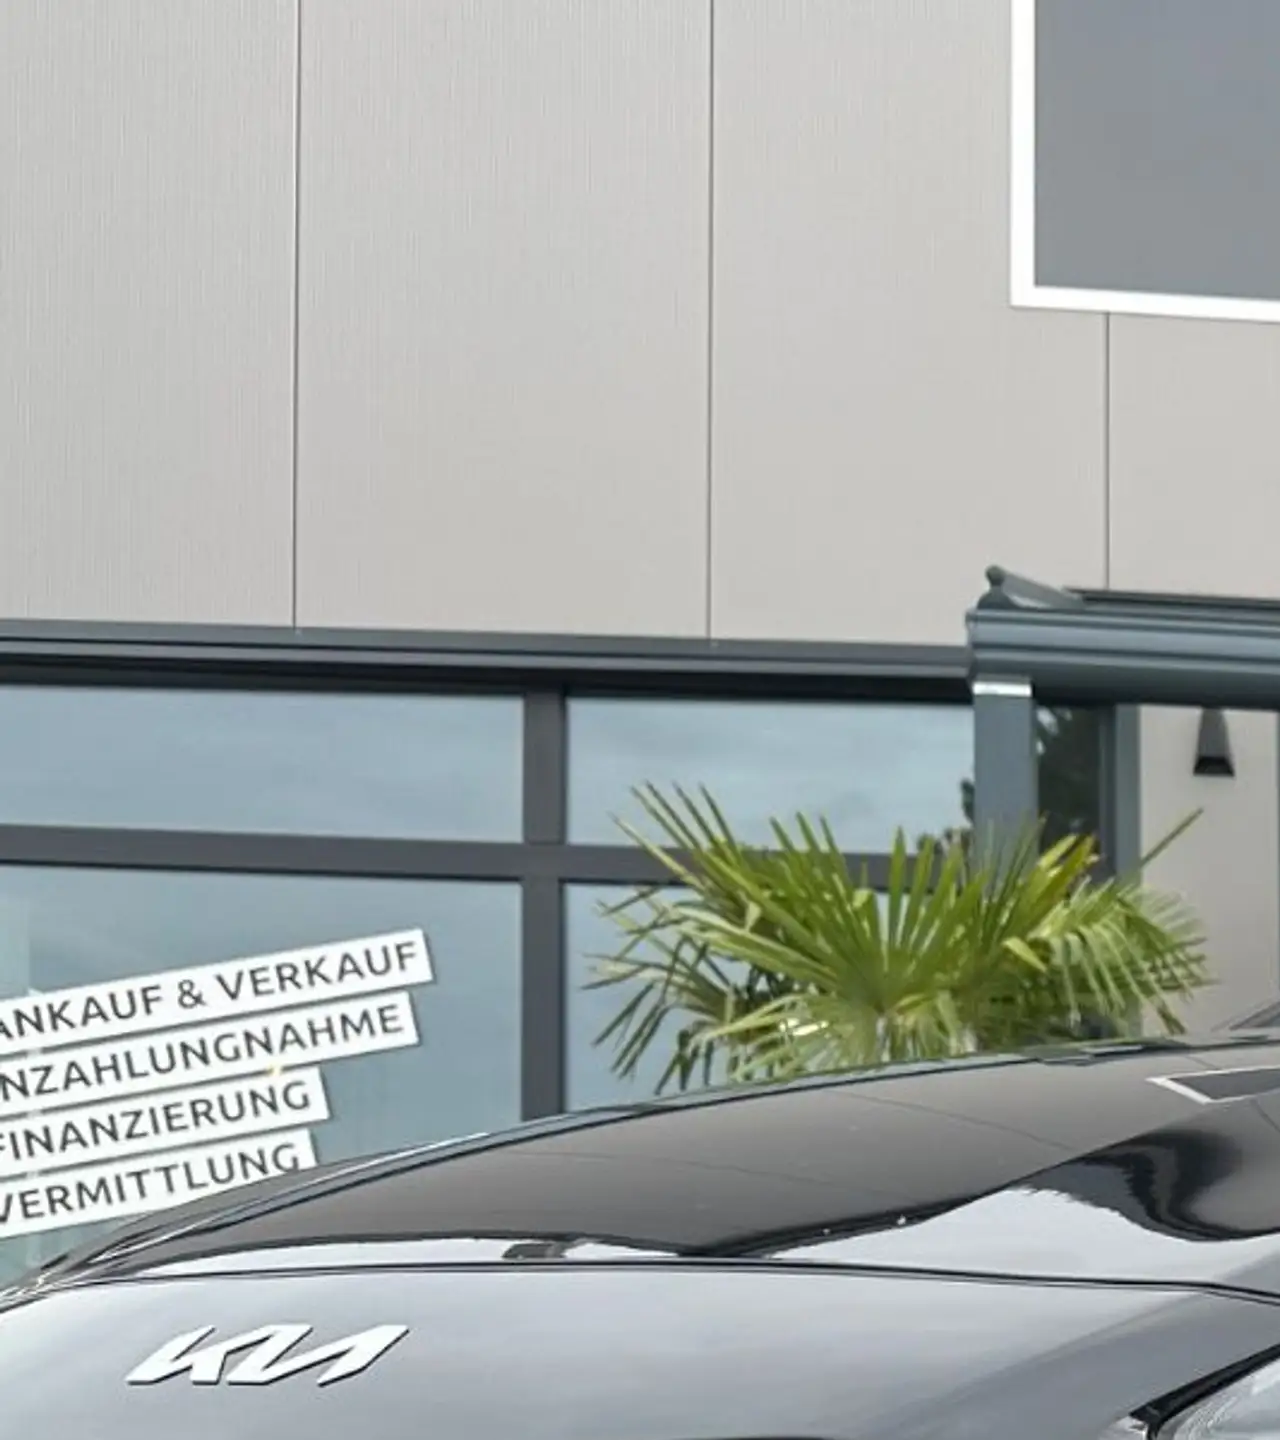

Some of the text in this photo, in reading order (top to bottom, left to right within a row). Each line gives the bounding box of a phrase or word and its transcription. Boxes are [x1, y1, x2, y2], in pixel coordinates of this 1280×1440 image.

[177, 980, 205, 1009] &
[215, 941, 418, 1002] VERKAUF
[125, 1324, 411, 1388] KIA
